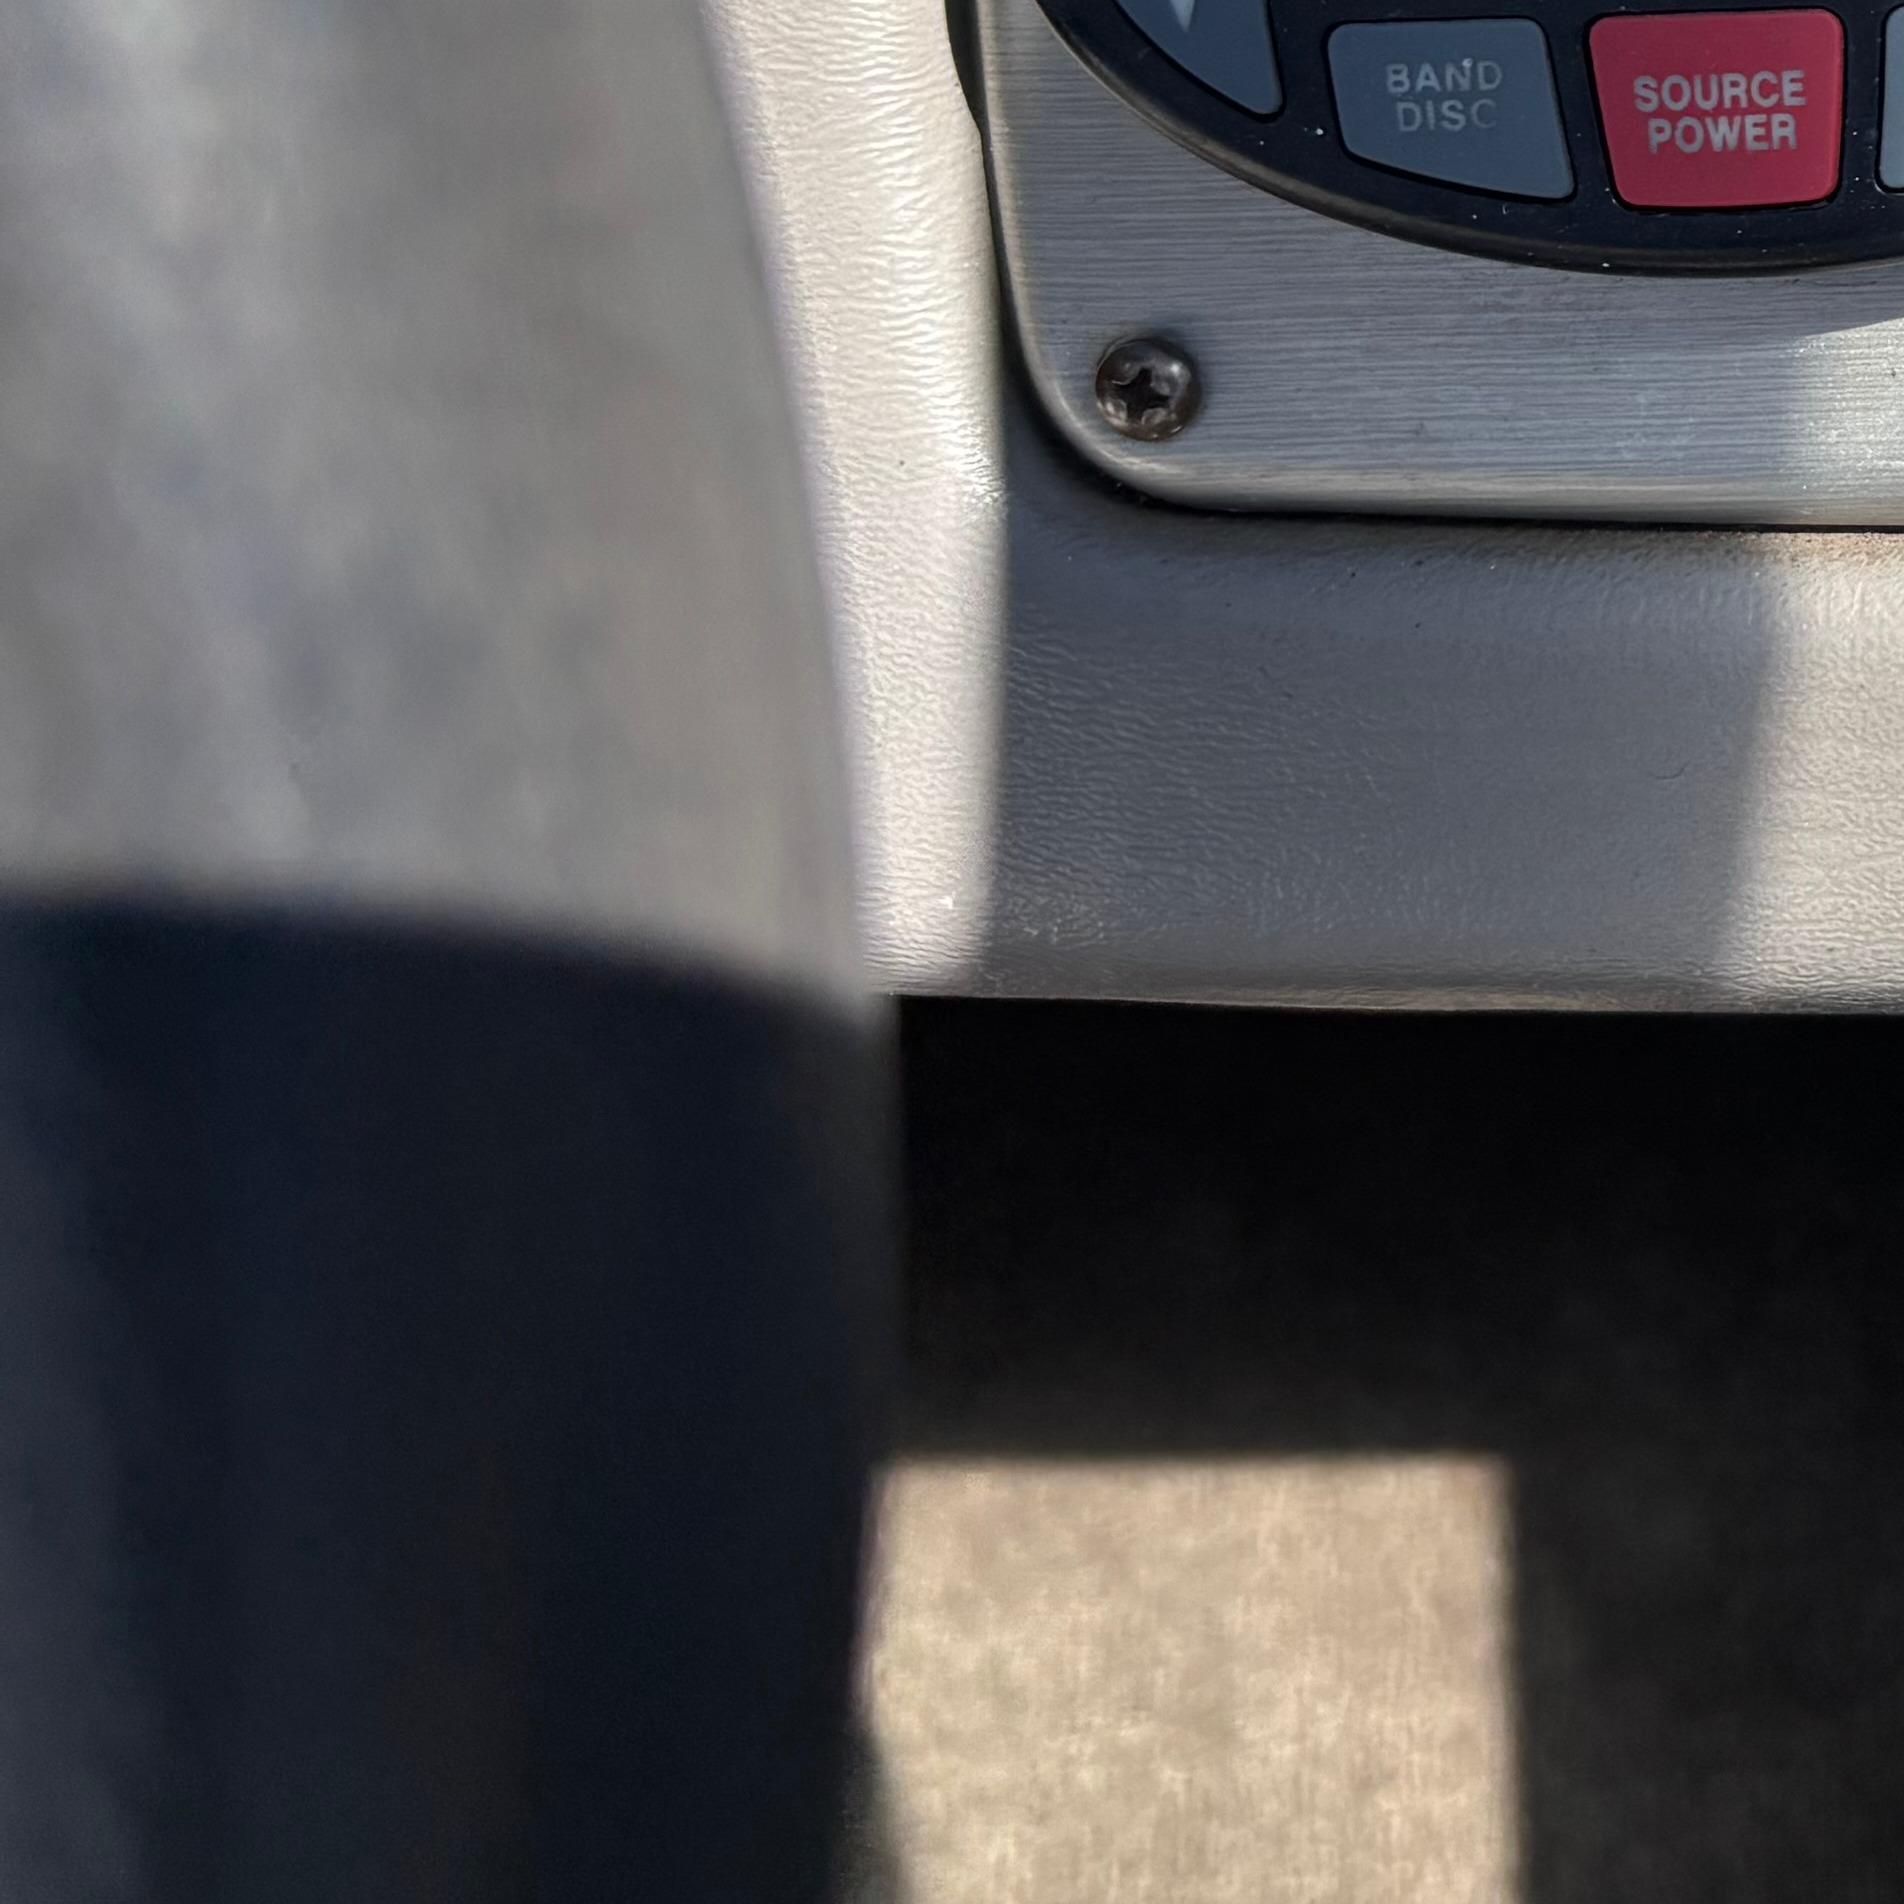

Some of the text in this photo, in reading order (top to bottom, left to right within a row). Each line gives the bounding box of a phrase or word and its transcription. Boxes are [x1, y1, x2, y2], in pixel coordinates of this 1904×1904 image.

[1386, 60, 1503, 95] BAND
[1633, 69, 1807, 112] SOURCE
[1396, 98, 1498, 133] DISC
[1647, 113, 1797, 155] POWER
